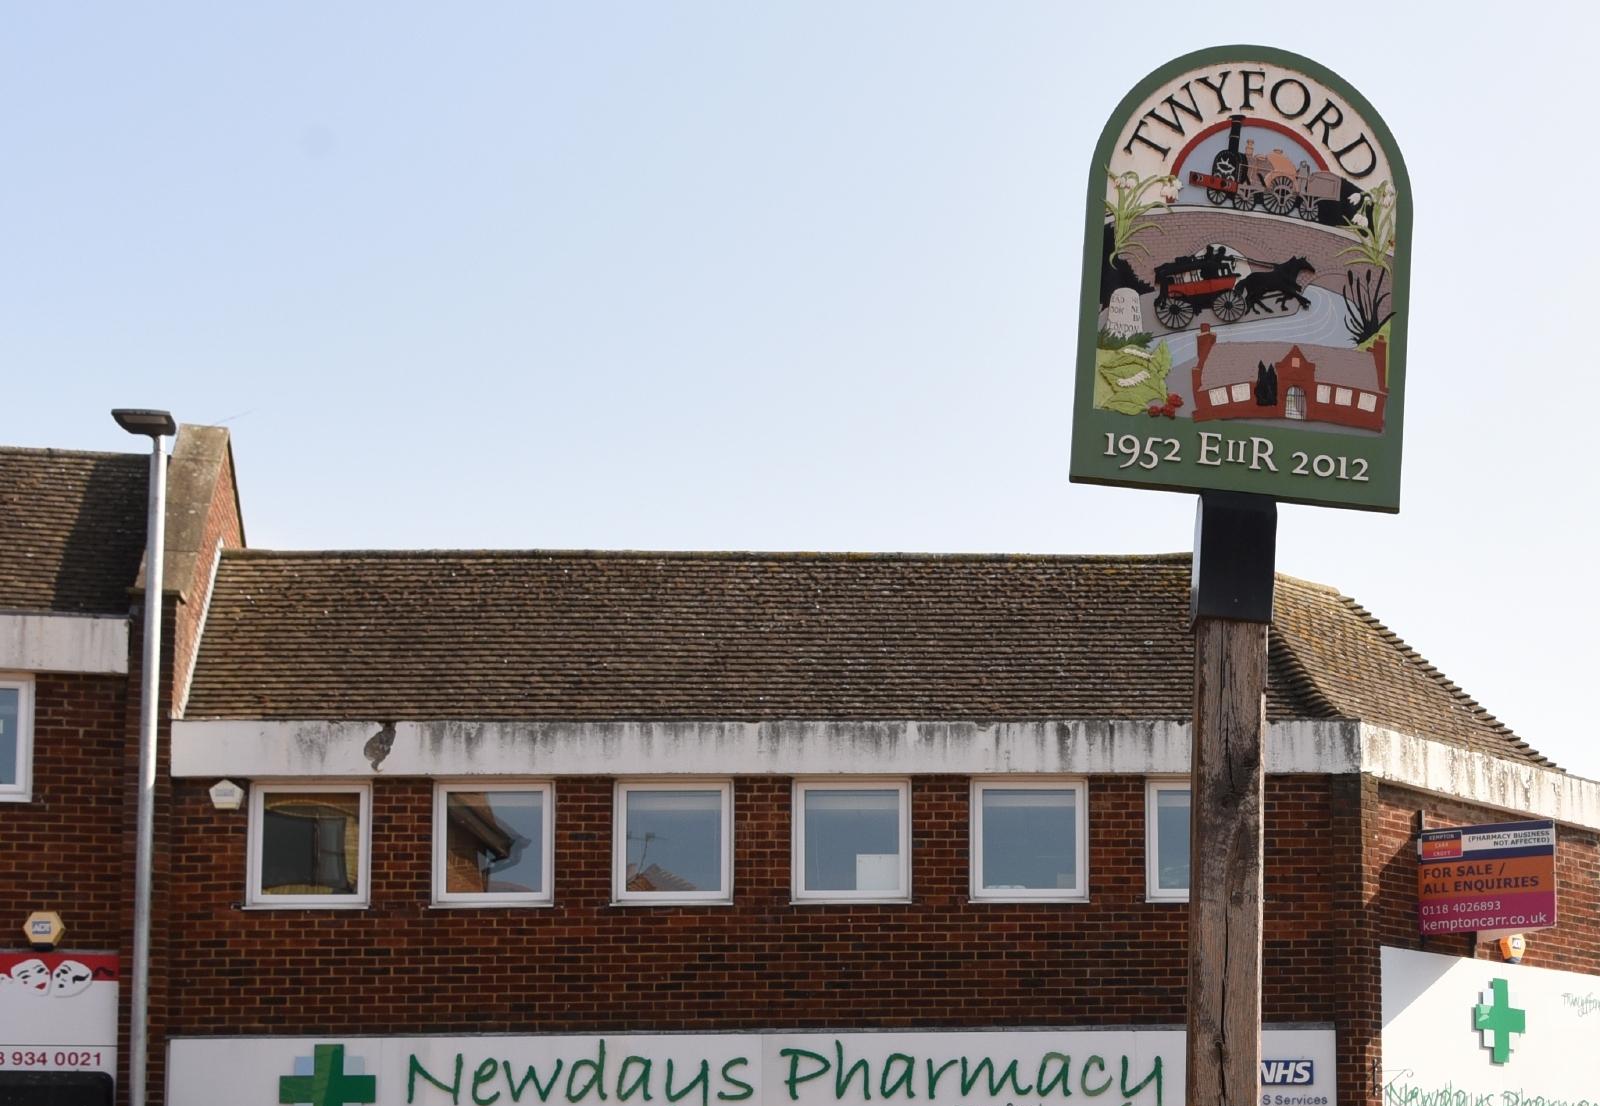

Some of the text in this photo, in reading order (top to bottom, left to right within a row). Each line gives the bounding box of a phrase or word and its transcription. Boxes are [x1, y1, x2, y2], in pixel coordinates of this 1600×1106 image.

[1123, 70, 1377, 179] TWYFORD
[1103, 432, 1182, 469] 1952
[1291, 451, 1369, 481] 2012
[1468, 830, 1550, 842] (PHARMACY BUSINESS
[1510, 837, 1551, 846] AFFECTED)
[1423, 862, 1506, 879] FOR SALE /
[1423, 876, 1539, 894] ALL ENQUIRIES
[1422, 901, 1501, 916] 0118 4026893
[1423, 912, 1547, 931] kemptoncarr.co.uk
[12, 1051, 47, 1066] 934
[54, 1051, 101, 1066] 0021
[1261, 1062, 1312, 1083] NHS
[1275, 1095, 1328, 1105] Services
